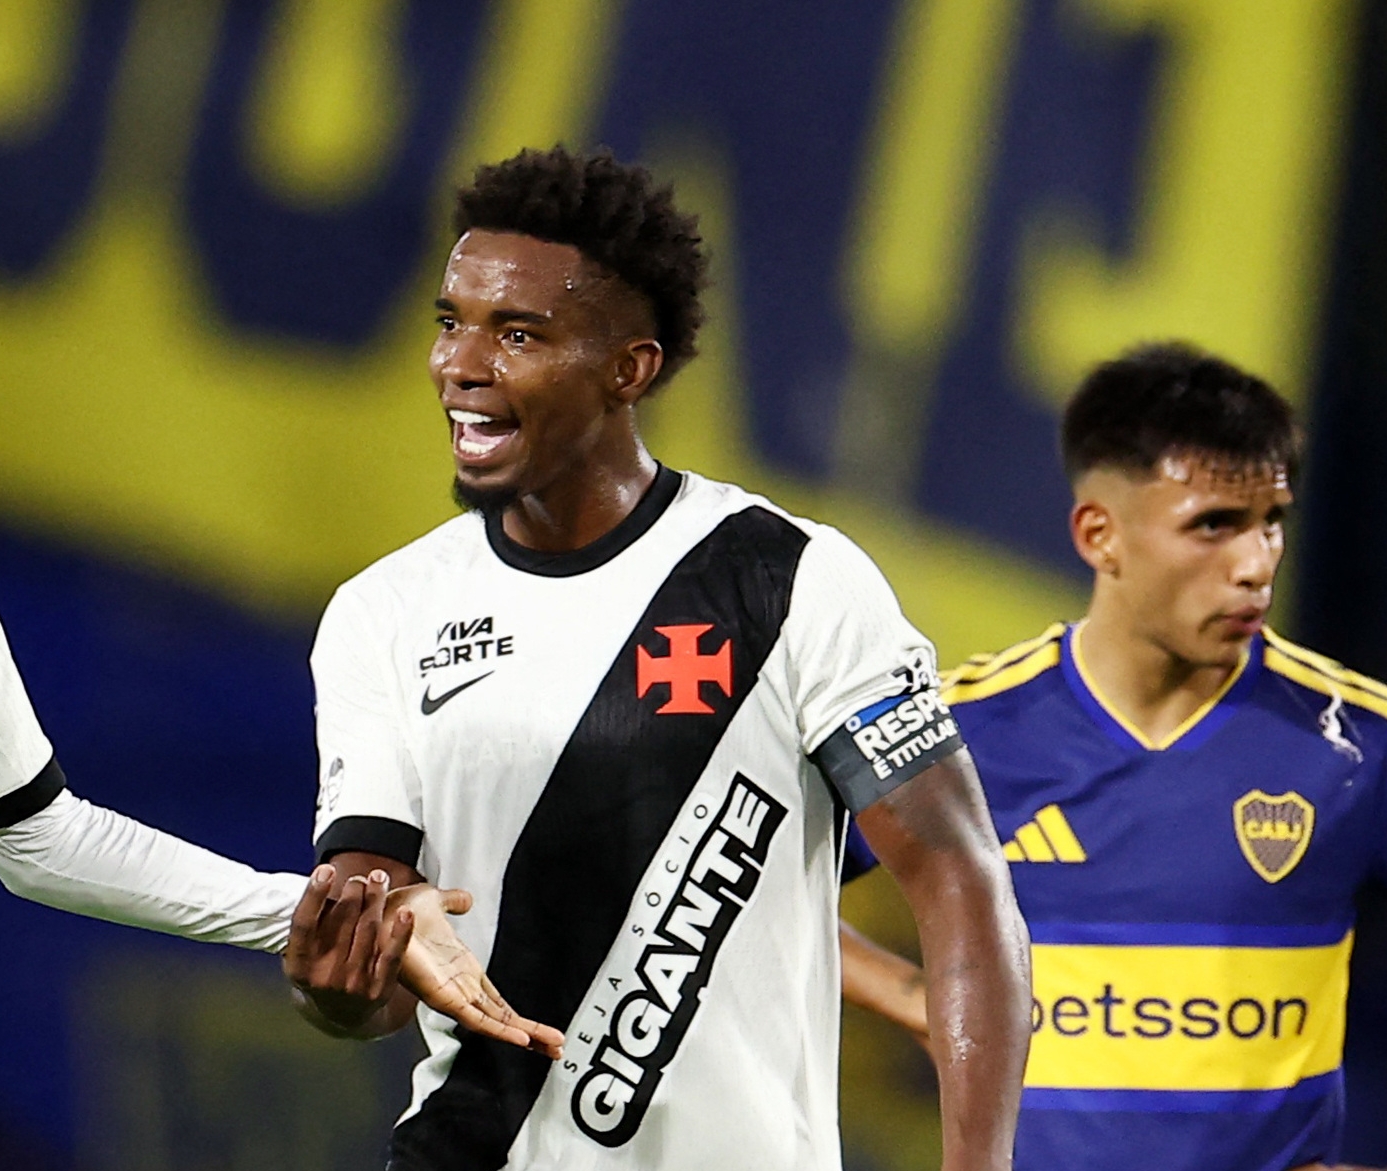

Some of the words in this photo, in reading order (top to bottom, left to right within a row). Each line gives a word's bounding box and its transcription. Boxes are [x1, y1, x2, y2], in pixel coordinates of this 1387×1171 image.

[872, 755, 893, 780] É
[887, 718, 958, 768] TITULAR
[564, 975, 622, 1073] SEJA
[632, 804, 708, 937] SÓCIO
[577, 780, 772, 1136] GIGANTE
